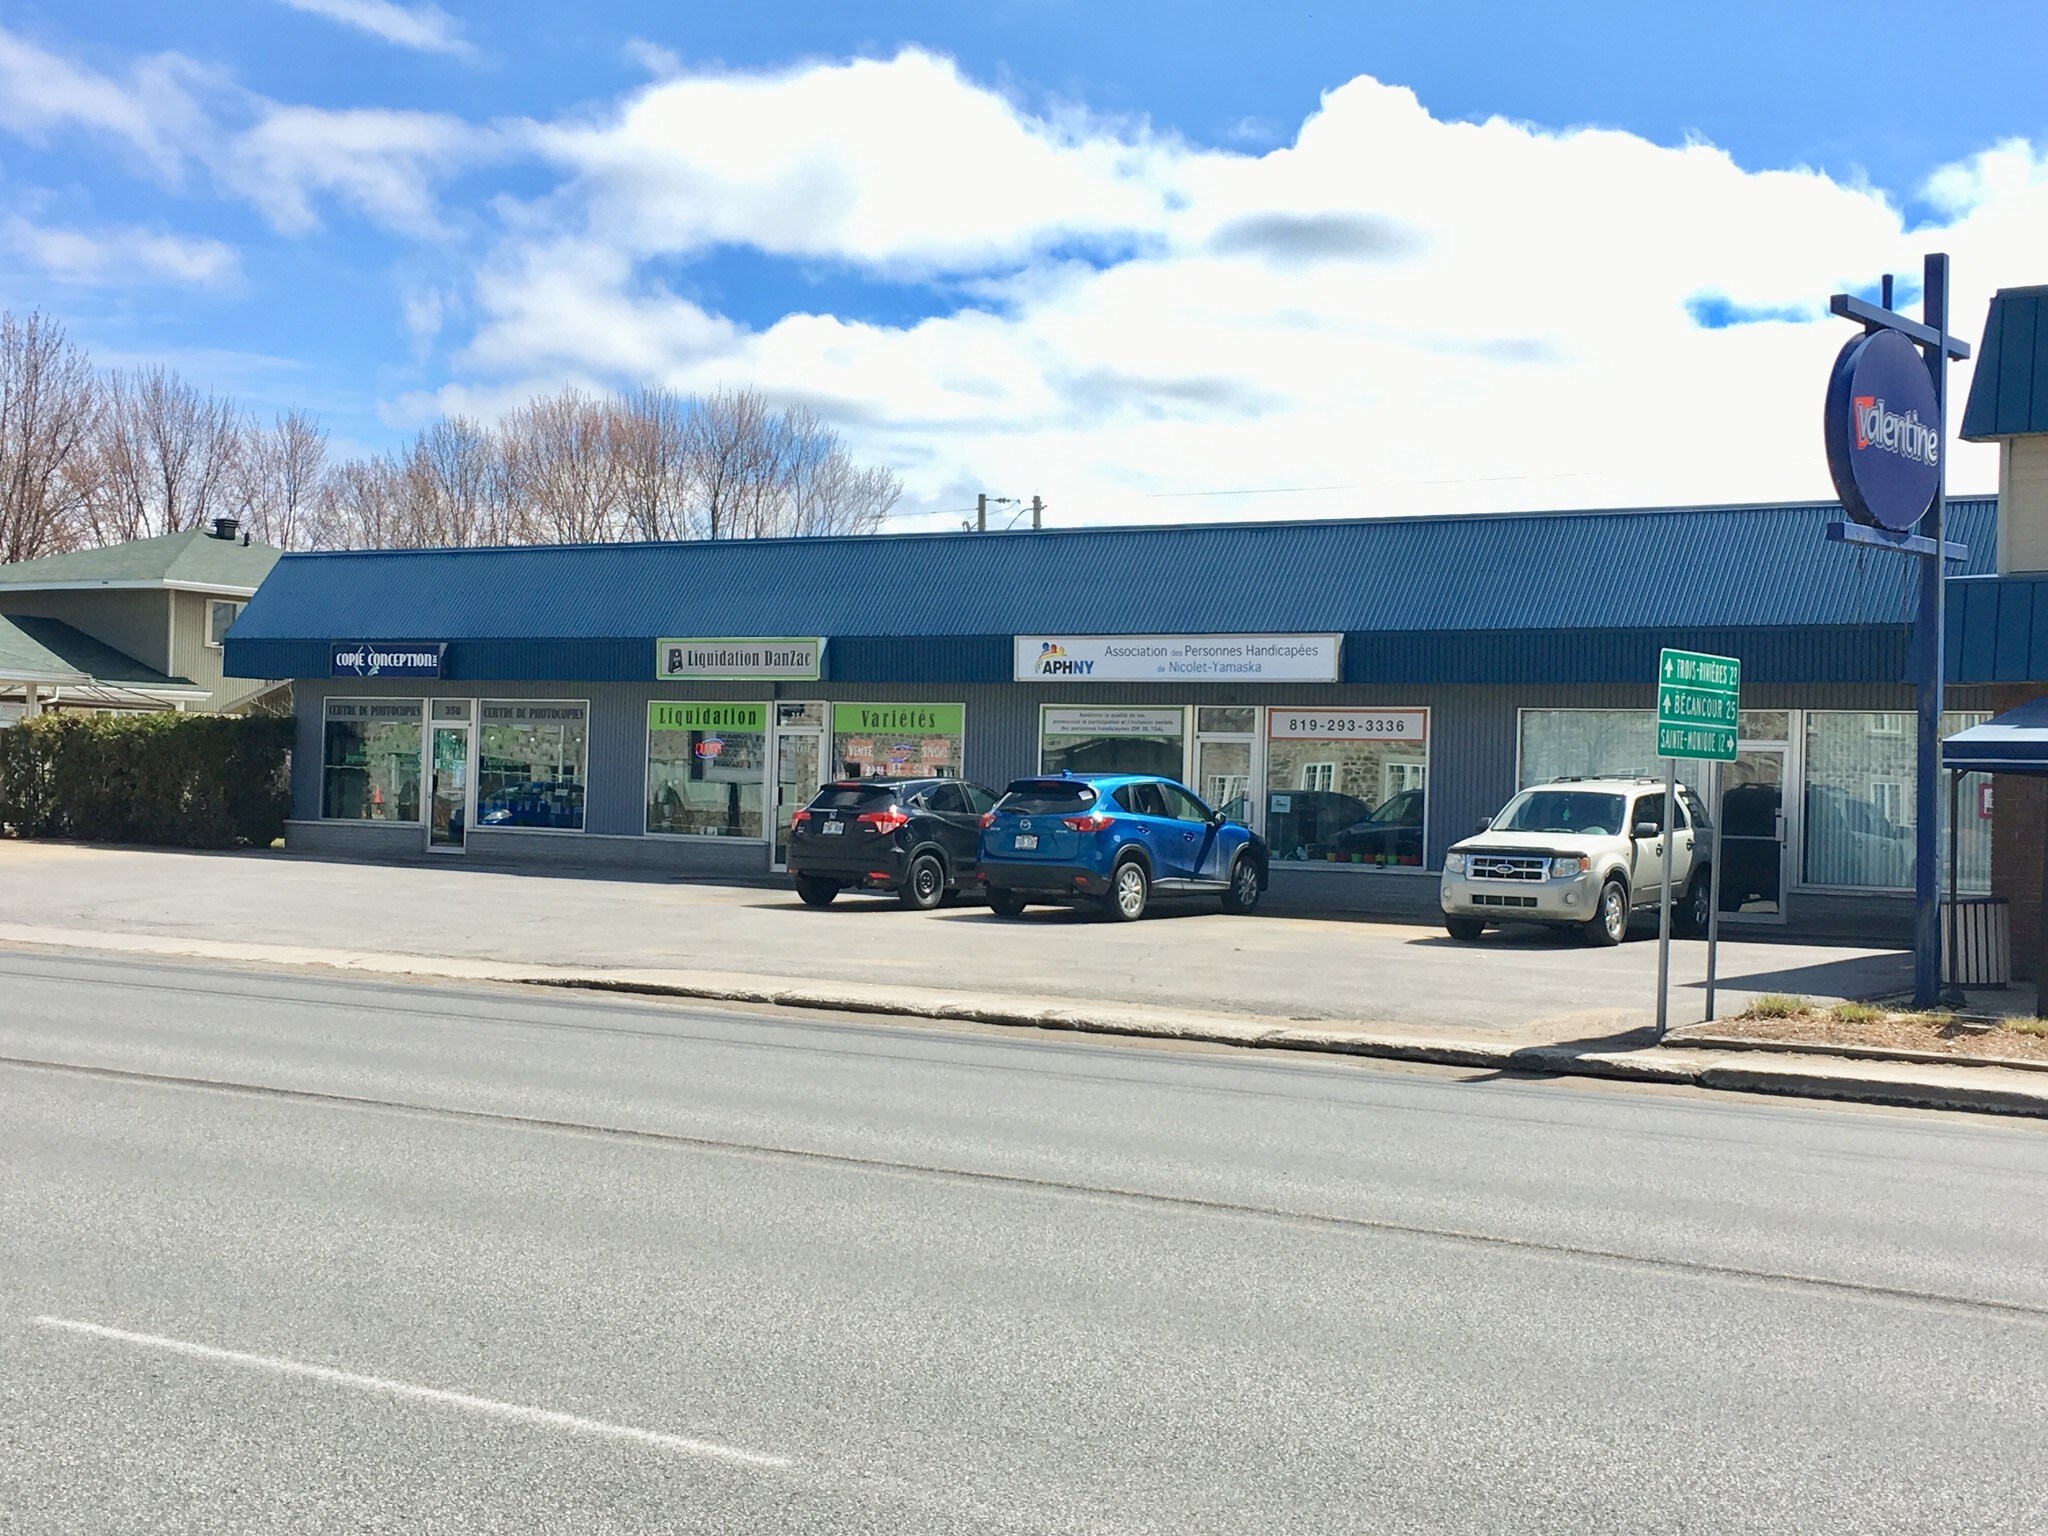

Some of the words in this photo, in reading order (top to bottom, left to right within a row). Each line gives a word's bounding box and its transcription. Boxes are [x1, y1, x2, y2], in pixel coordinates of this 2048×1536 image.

[1854, 396, 1939, 467] Valentine
[336, 652, 365, 667] COPIE
[367, 652, 432, 667] CONCEPTION
[688, 650, 760, 669] Liquidation
[764, 650, 811, 667] DanZac
[1104, 645, 1167, 657] Association
[1170, 649, 1183, 657] des
[1184, 645, 1242, 657] Personnes
[1245, 644, 1319, 659] Handicapées
[1042, 660, 1095, 675] APHNY
[1156, 664, 1166, 673] de
[1168, 661, 1262, 673] Nicolet-Yamaska
[1676, 658, 1728, 685] TROIS-RIVIÈRES
[1674, 691, 1723, 719] BÉCANCOUR
[1726, 700, 1737, 720] 25
[659, 707, 757, 727] Liquidation
[861, 709, 936, 728] Variétés
[1289, 719, 1405, 732] 819-293-3336
[1660, 728, 1716, 752] SAINTE-MONIQUE
[1718, 733, 1726, 753] 12
